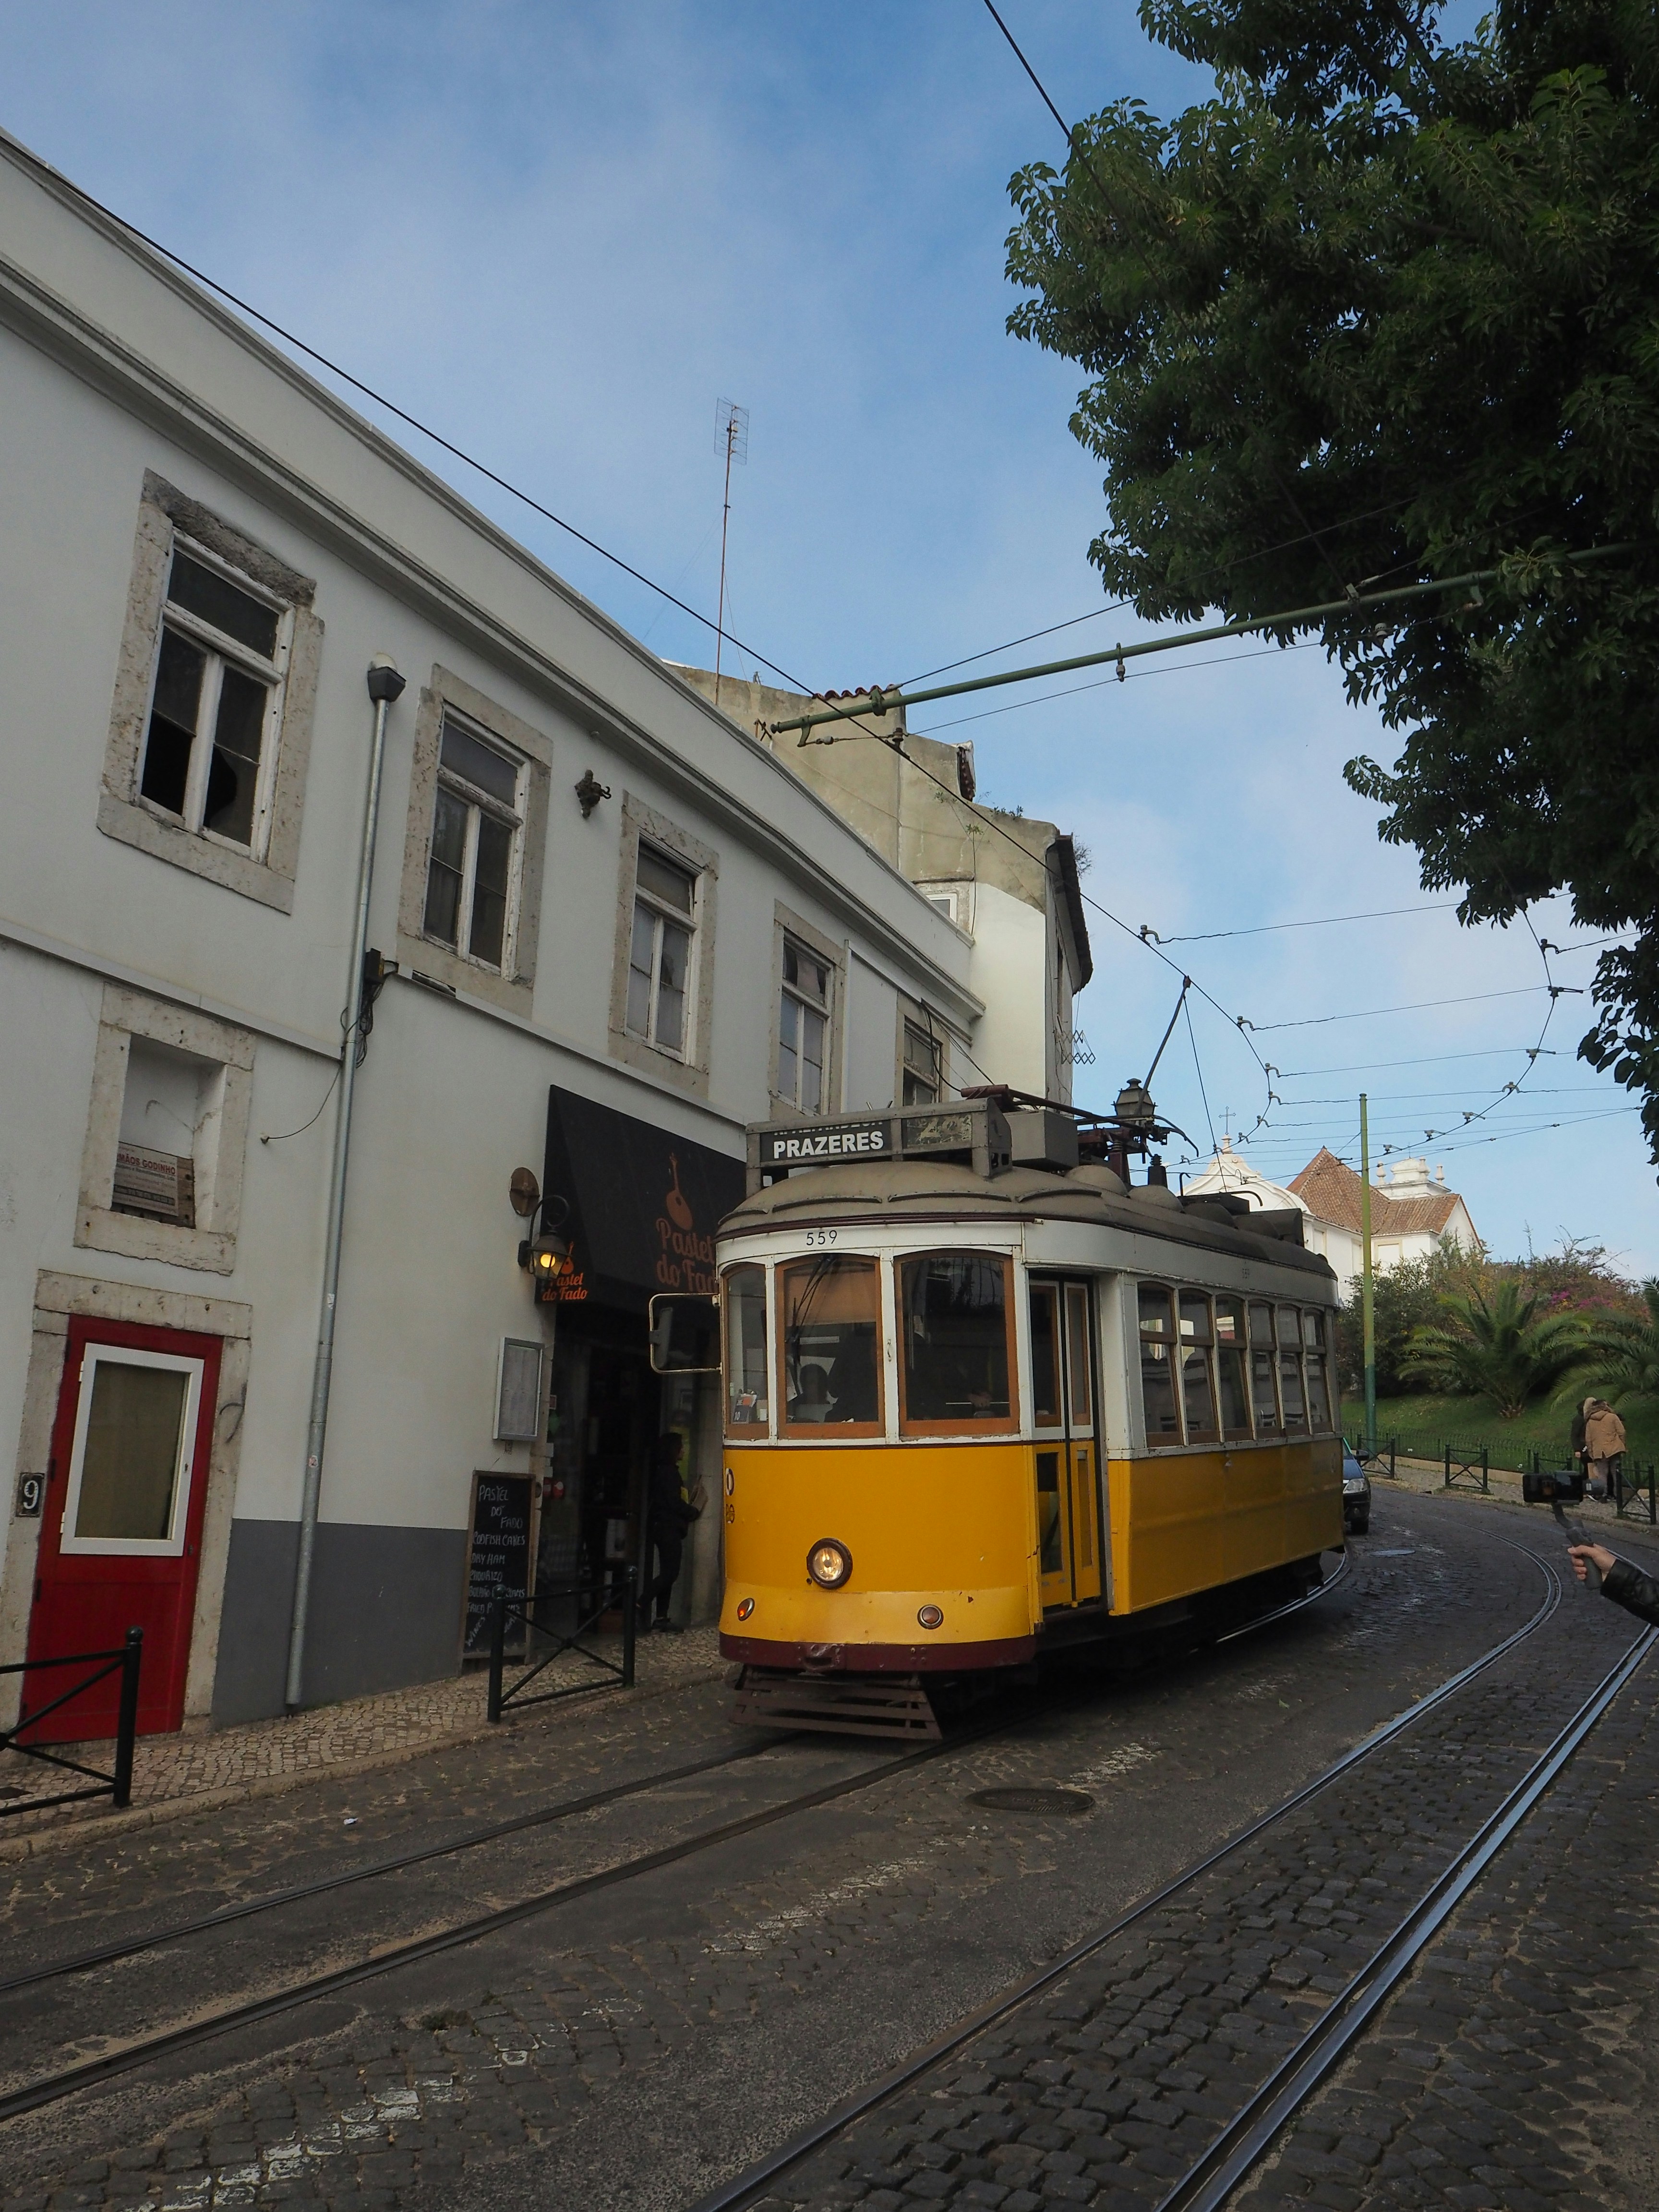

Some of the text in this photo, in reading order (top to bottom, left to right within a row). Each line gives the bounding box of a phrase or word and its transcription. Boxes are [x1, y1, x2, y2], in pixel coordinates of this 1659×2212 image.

[773, 1130, 884, 1159] PRAZERES
[143, 1160, 176, 1175] GODINHO
[656, 1218, 715, 1265] Pastel
[806, 1230, 837, 1246] 559
[657, 1254, 720, 1294] do Fad
[542, 1286, 589, 1301] do Fado
[23, 1480, 39, 1509] 9
[479, 1484, 509, 1502] PASTEL
[491, 1505, 505, 1516] DO
[501, 1516, 523, 1529] FADO
[474, 1531, 525, 1546] CODFISH CAKES
[472, 1553, 505, 1565] DRY HAM
[468, 1602, 484, 1613] FRIED
